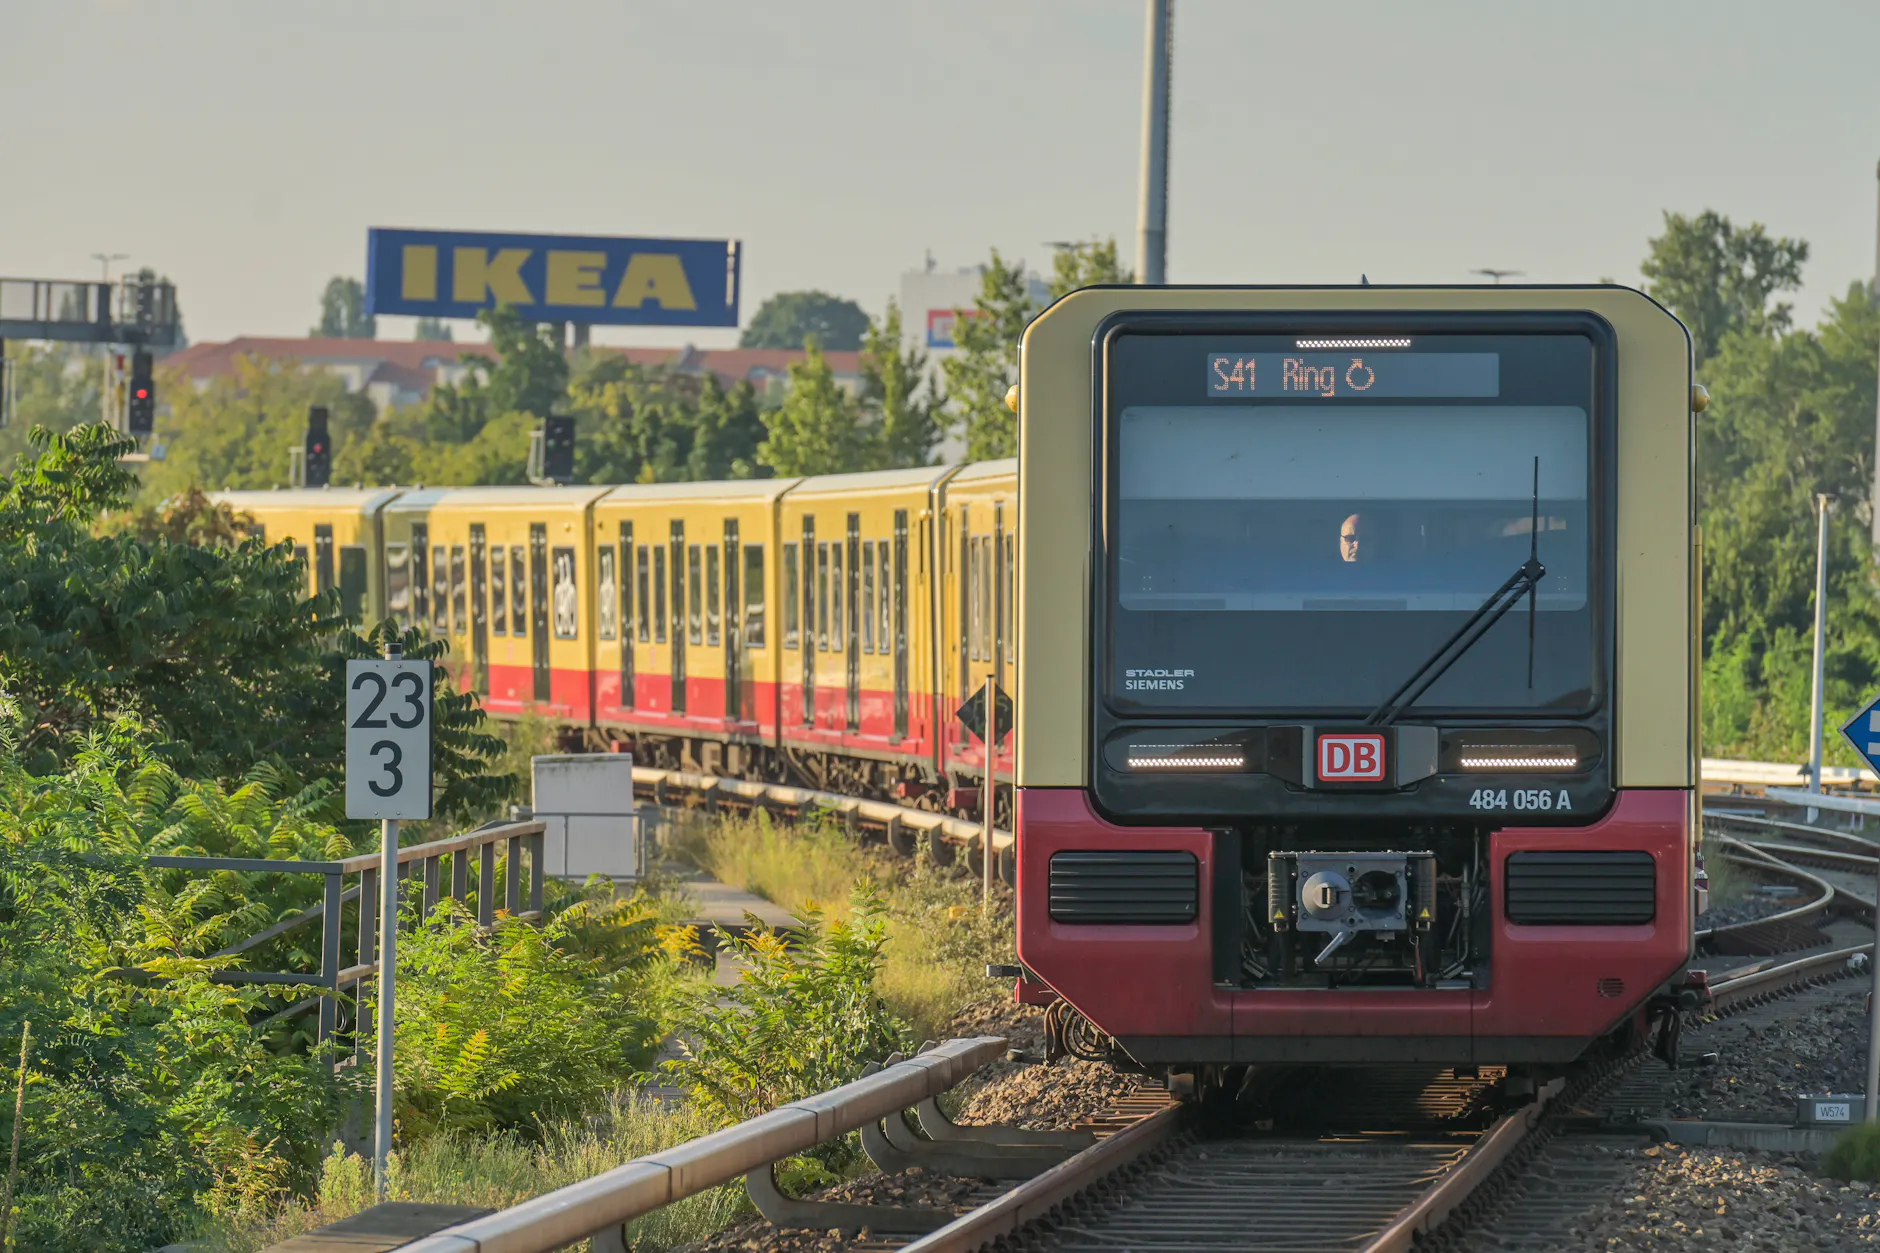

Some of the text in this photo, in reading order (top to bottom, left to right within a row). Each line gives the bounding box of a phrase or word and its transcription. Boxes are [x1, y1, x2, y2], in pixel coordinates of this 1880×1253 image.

[401, 245, 697, 311] IKEA
[1213, 358, 1336, 397] S41 Ring
[1125, 669, 1195, 677] STADLER
[1125, 679, 1185, 690] SIEMENS
[350, 671, 425, 729] 23
[367, 739, 403, 797] 3
[1326, 742, 1377, 773] DB
[1469, 789, 1572, 810] 484 056 A
[1820, 1106, 1845, 1117] W574
